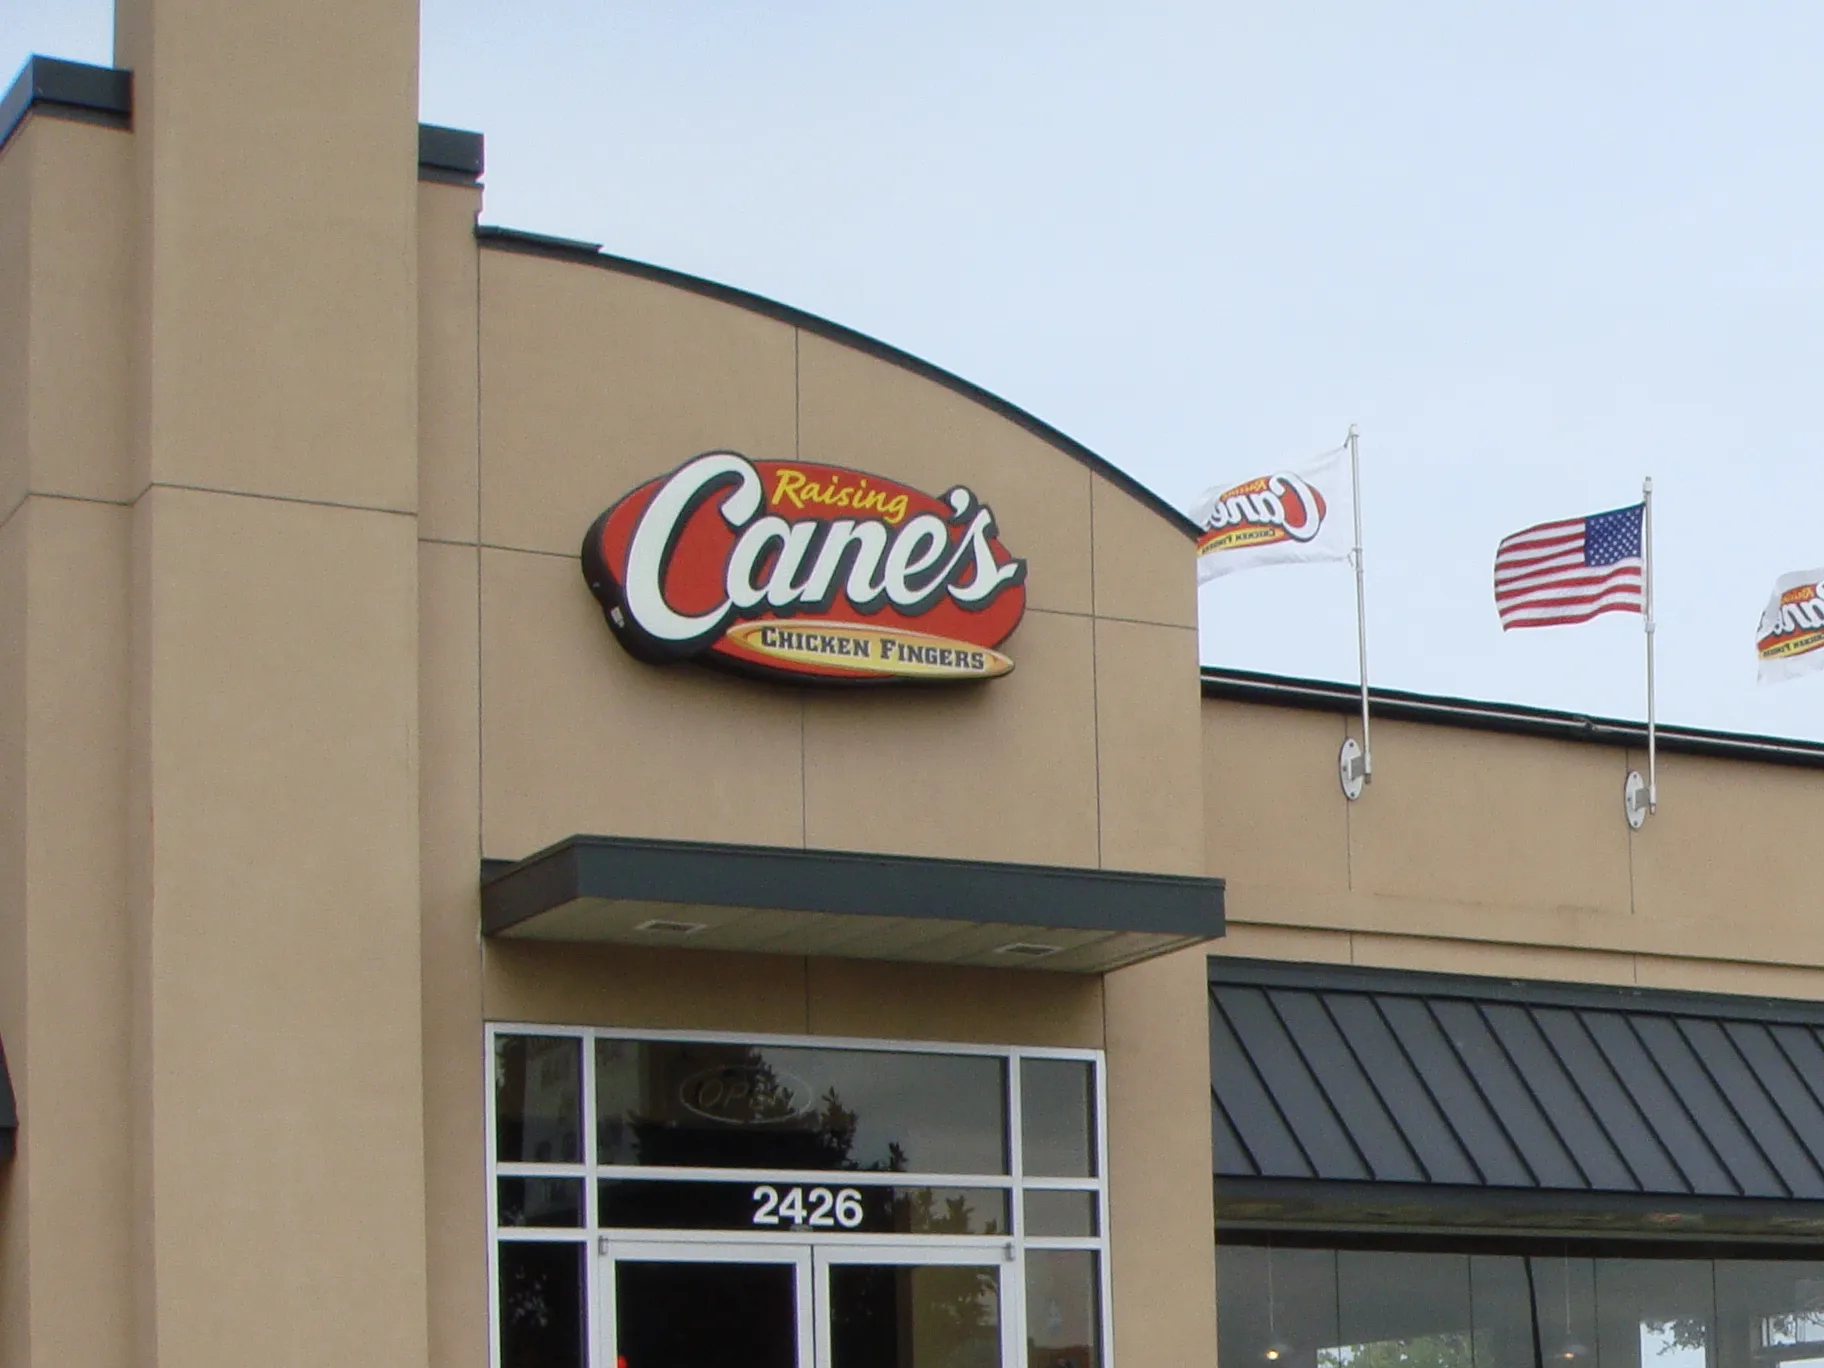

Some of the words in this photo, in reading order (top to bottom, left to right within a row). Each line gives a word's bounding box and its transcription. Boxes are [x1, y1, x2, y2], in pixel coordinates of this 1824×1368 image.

[771, 468, 908, 524] Raising
[625, 453, 1019, 640] Cane's
[752, 1184, 864, 1228] 2426
